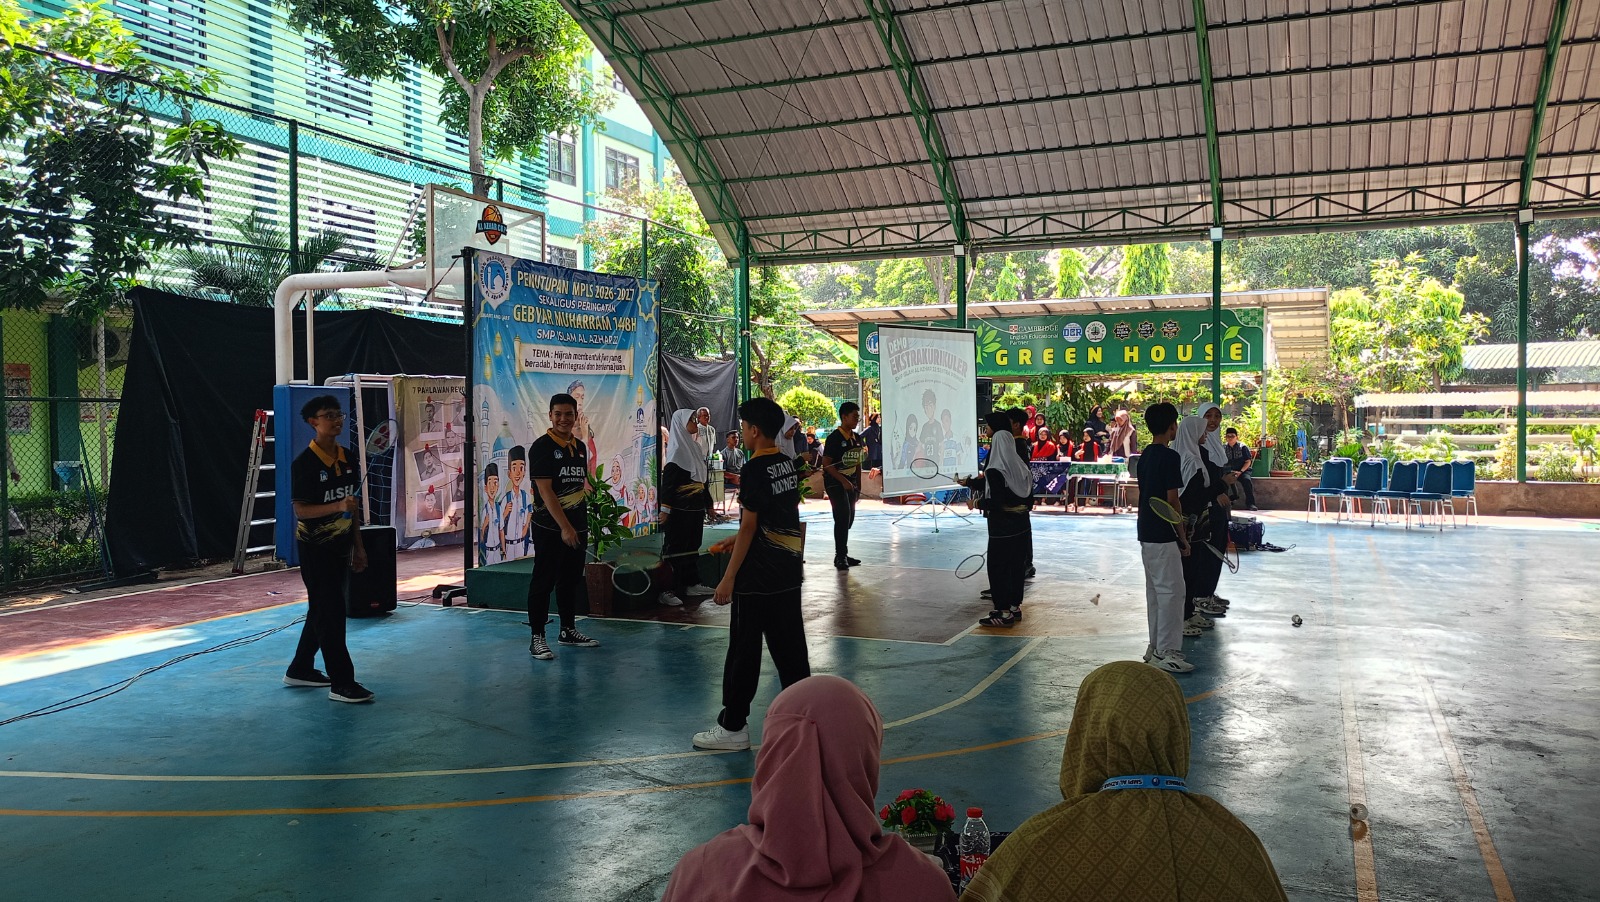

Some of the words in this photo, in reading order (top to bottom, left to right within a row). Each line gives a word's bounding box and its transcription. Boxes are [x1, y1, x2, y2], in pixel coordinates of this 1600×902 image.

[517, 270, 569, 295] PENUTUPAN
[572, 281, 594, 298] MPLS
[595, 285, 635, 301] 2026-2027
[538, 294, 576, 309] SEKALIGUS
[577, 301, 616, 313] PERINGATAN
[513, 304, 554, 326] GEBYAR
[554, 310, 612, 331] MUHARRAM
[1018, 324, 1059, 332] CAMBRIDGE
[536, 329, 556, 340] SMP
[556, 331, 577, 343] ISLAM
[578, 334, 588, 344] AL
[589, 335, 612, 345] AZHAR
[888, 337, 907, 354] DEMO
[532, 349, 550, 359] TEMA
[889, 347, 968, 378] EKSTRAKURIKULER
[995, 346, 1103, 366] GREEN
[1123, 342, 1243, 364] HOUSE
[417, 386, 450, 394] PAHLAWAN
[559, 466, 586, 477] ALSEN
